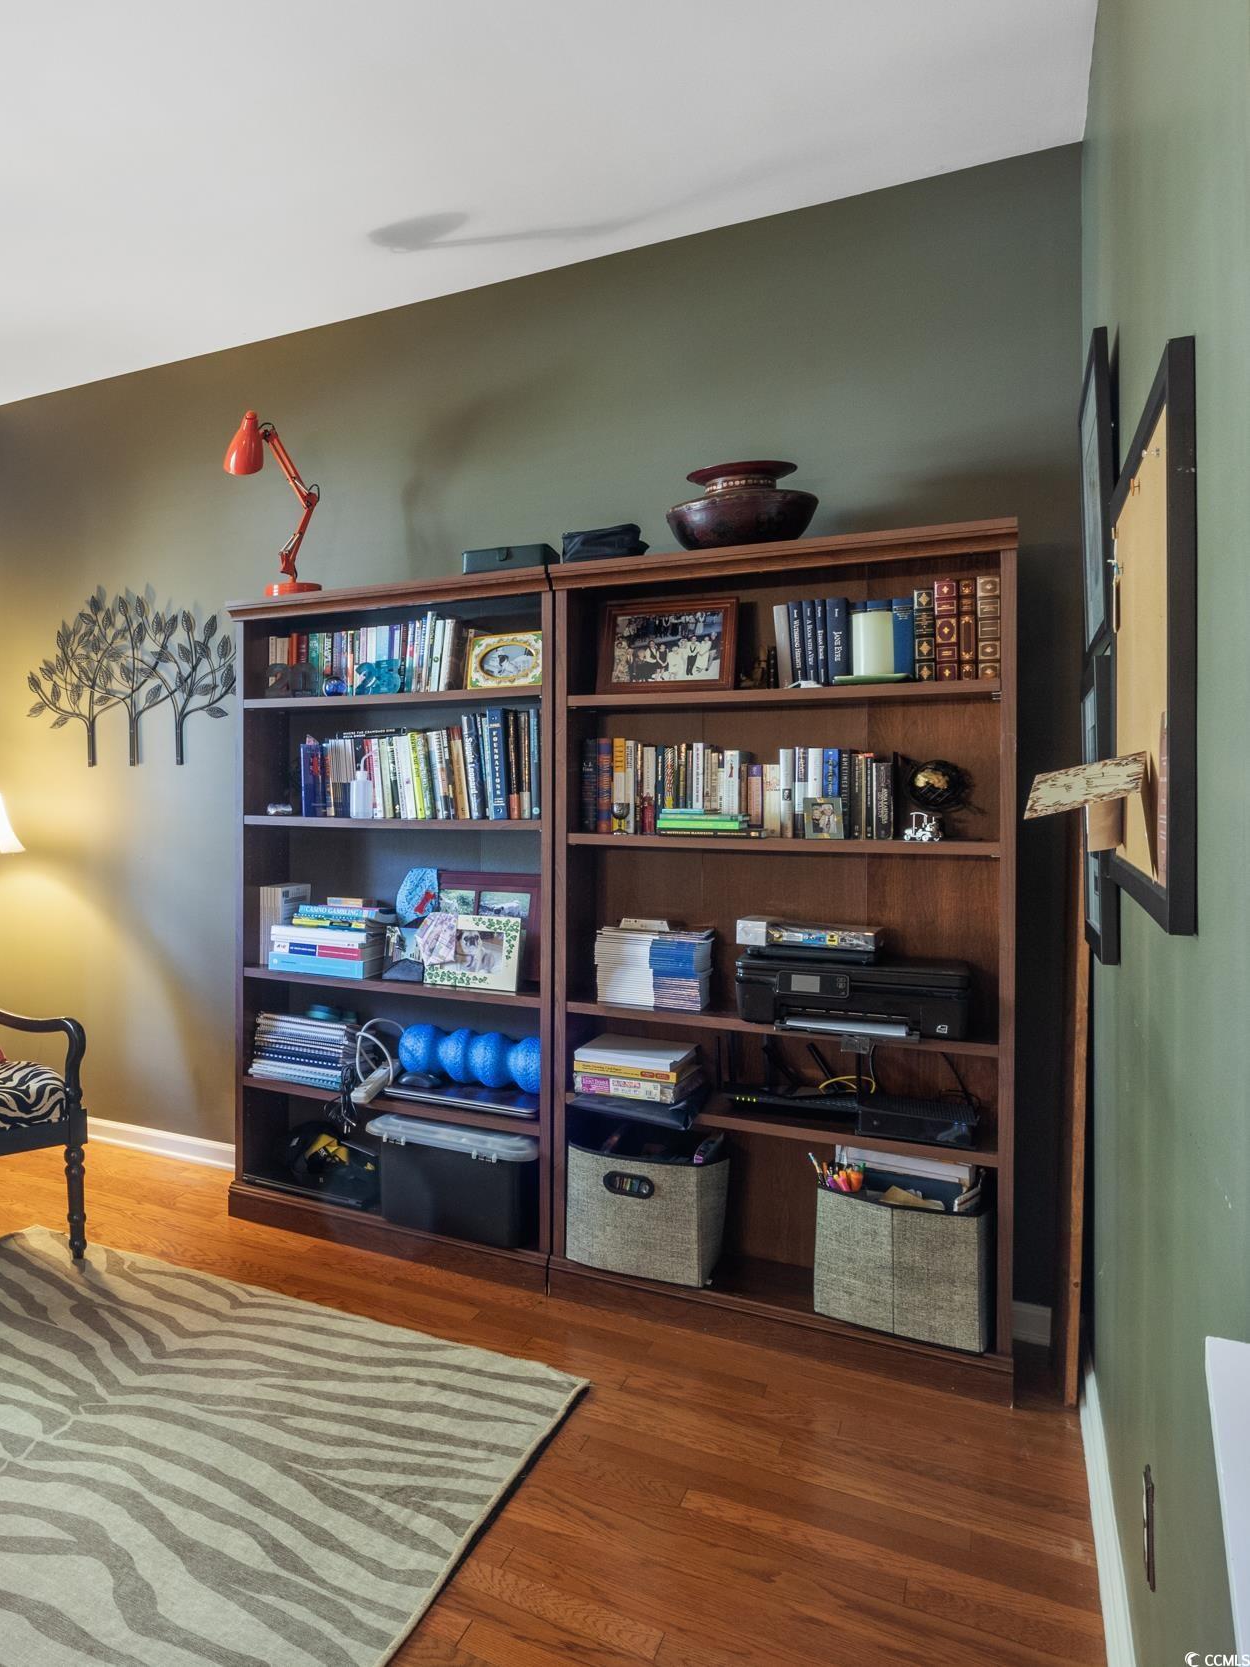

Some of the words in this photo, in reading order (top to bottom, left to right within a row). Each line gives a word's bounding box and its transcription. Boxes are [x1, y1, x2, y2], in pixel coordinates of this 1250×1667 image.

[833, 631, 842, 646] JANE
[835, 646, 843, 662] EYRE
[492, 731, 501, 795] FOUNDATIONS
[468, 763, 478, 794] Leopard
[305, 905, 327, 913] CASINO
[328, 907, 359, 916] GAMBLING
